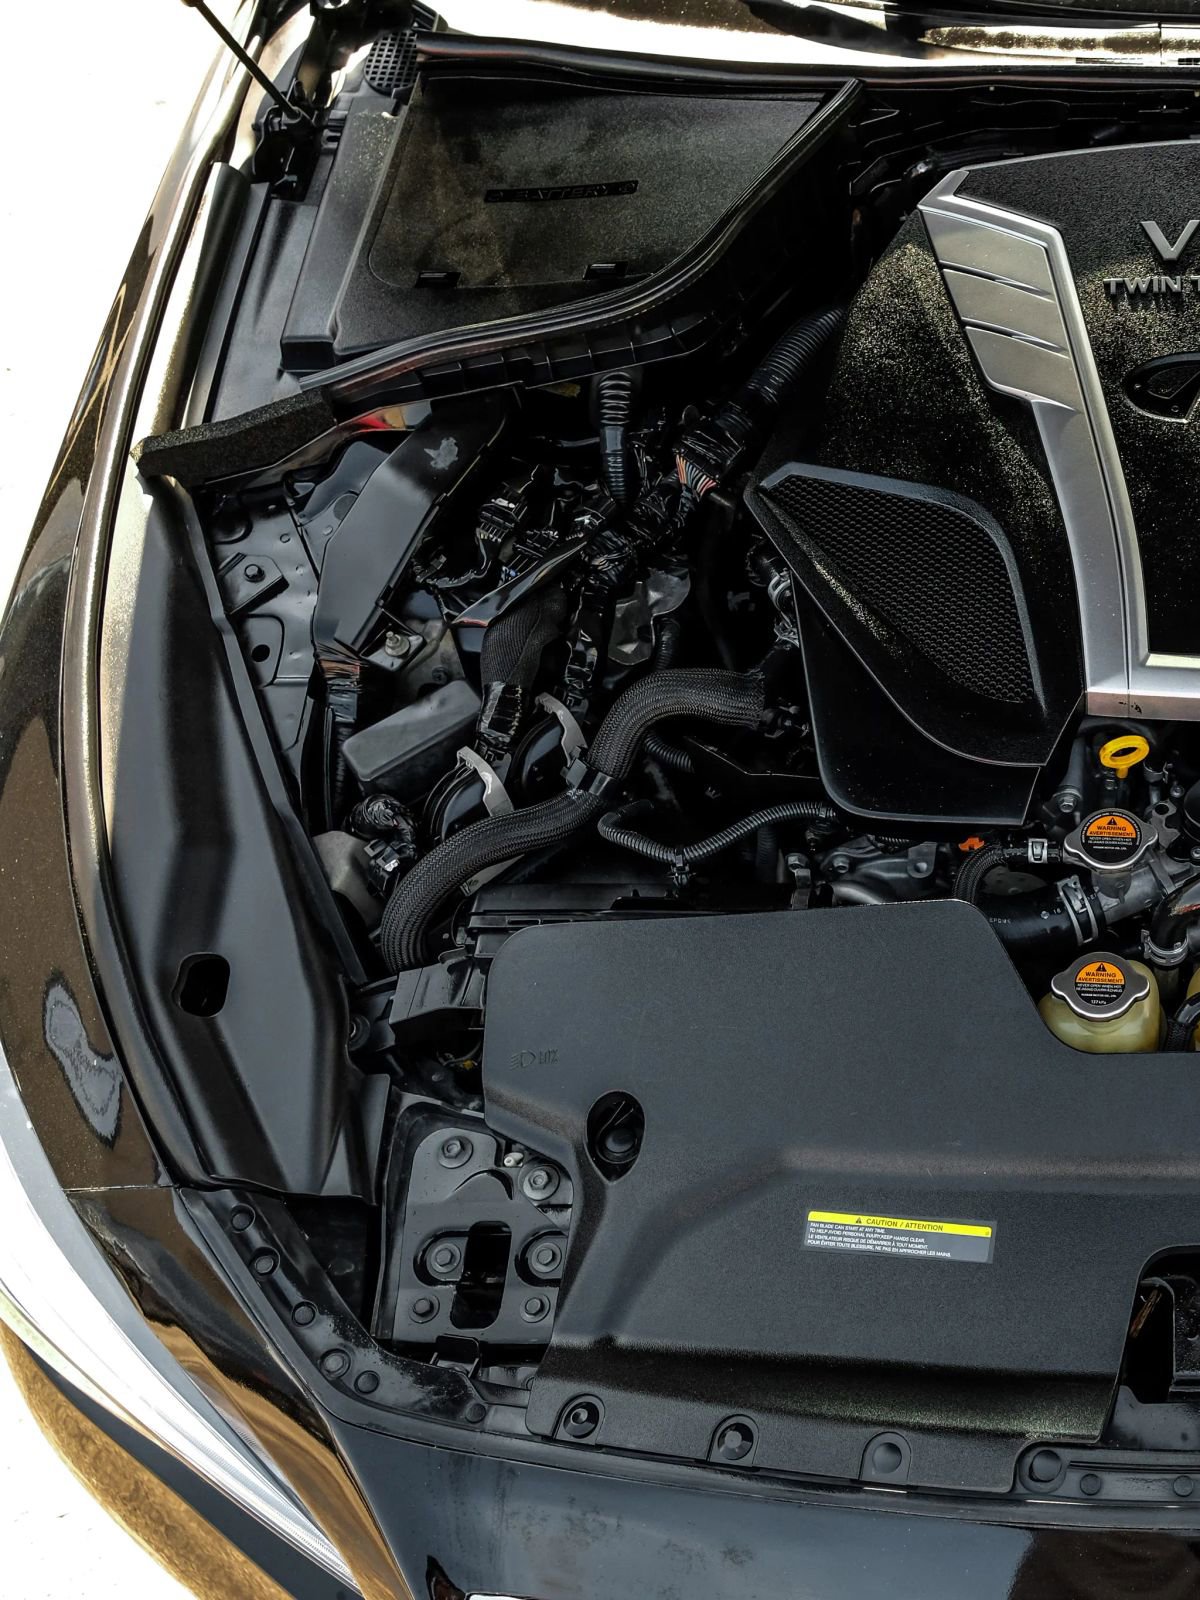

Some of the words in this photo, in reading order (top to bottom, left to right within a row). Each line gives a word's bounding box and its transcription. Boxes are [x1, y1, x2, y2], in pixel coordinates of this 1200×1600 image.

[513, 184, 608, 201] BATTERY
[1103, 275, 1182, 294] TWIN
[866, 1218, 898, 1227] CAUTION
[905, 1222, 944, 1232] ATTENTION
